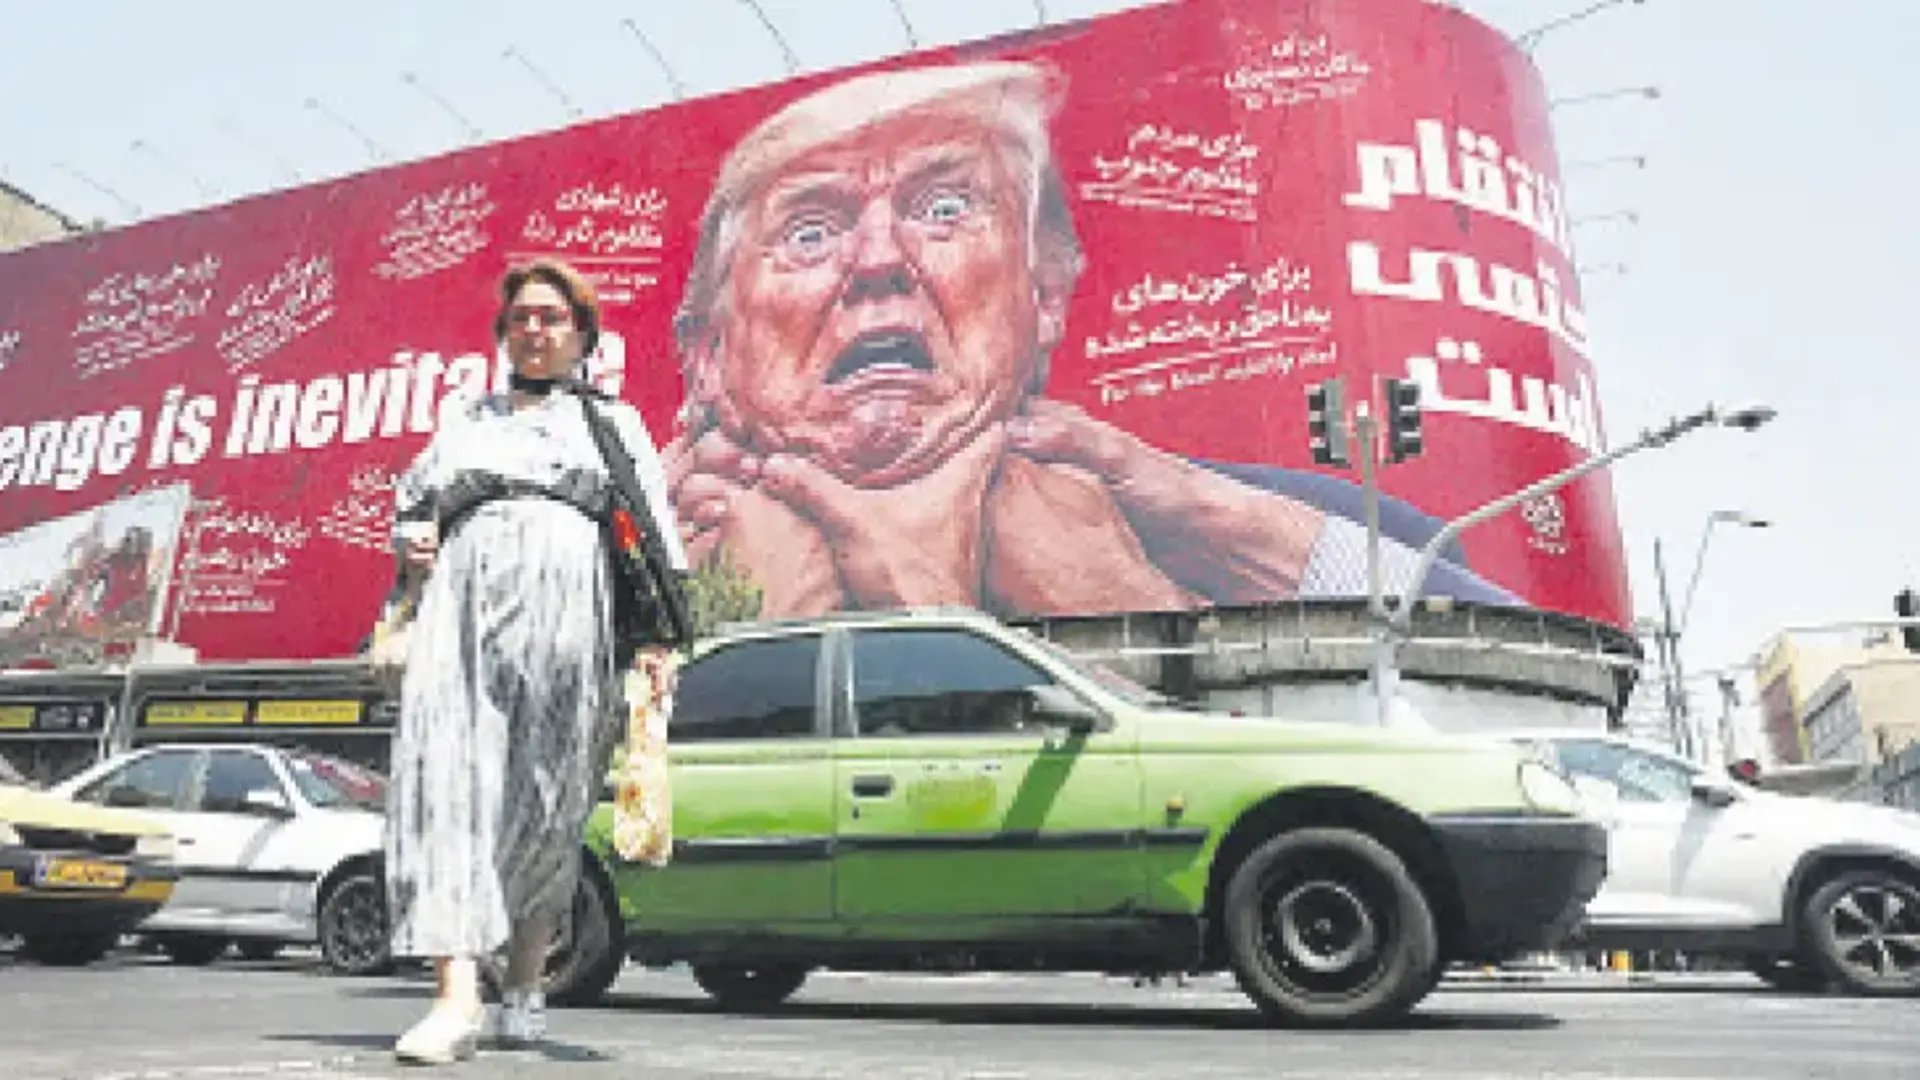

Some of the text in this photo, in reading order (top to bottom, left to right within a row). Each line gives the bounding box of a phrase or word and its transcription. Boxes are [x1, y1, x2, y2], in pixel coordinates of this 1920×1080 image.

[1341, 117, 1572, 259] انتقام
[1251, 257, 1311, 295] برای
[1346, 240, 1592, 356] حتمی
[146, 384, 217, 469] is
[1405, 337, 1606, 458] است
